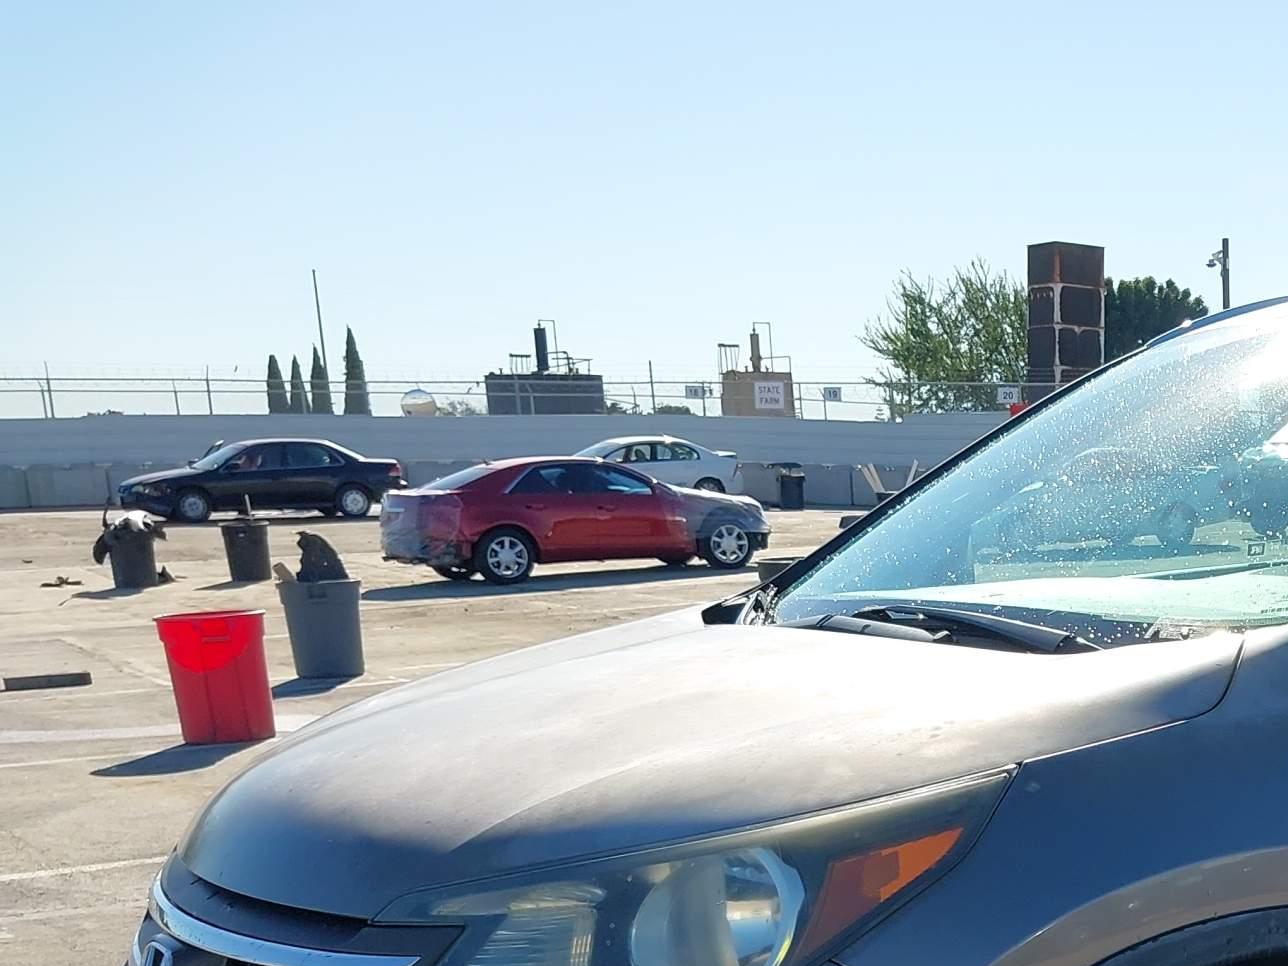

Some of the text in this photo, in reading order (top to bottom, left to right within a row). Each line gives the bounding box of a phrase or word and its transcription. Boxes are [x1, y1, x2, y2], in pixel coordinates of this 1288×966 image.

[758, 386, 780, 395] STATE
[1002, 391, 1014, 400] 20
[760, 396, 780, 405] FARM
